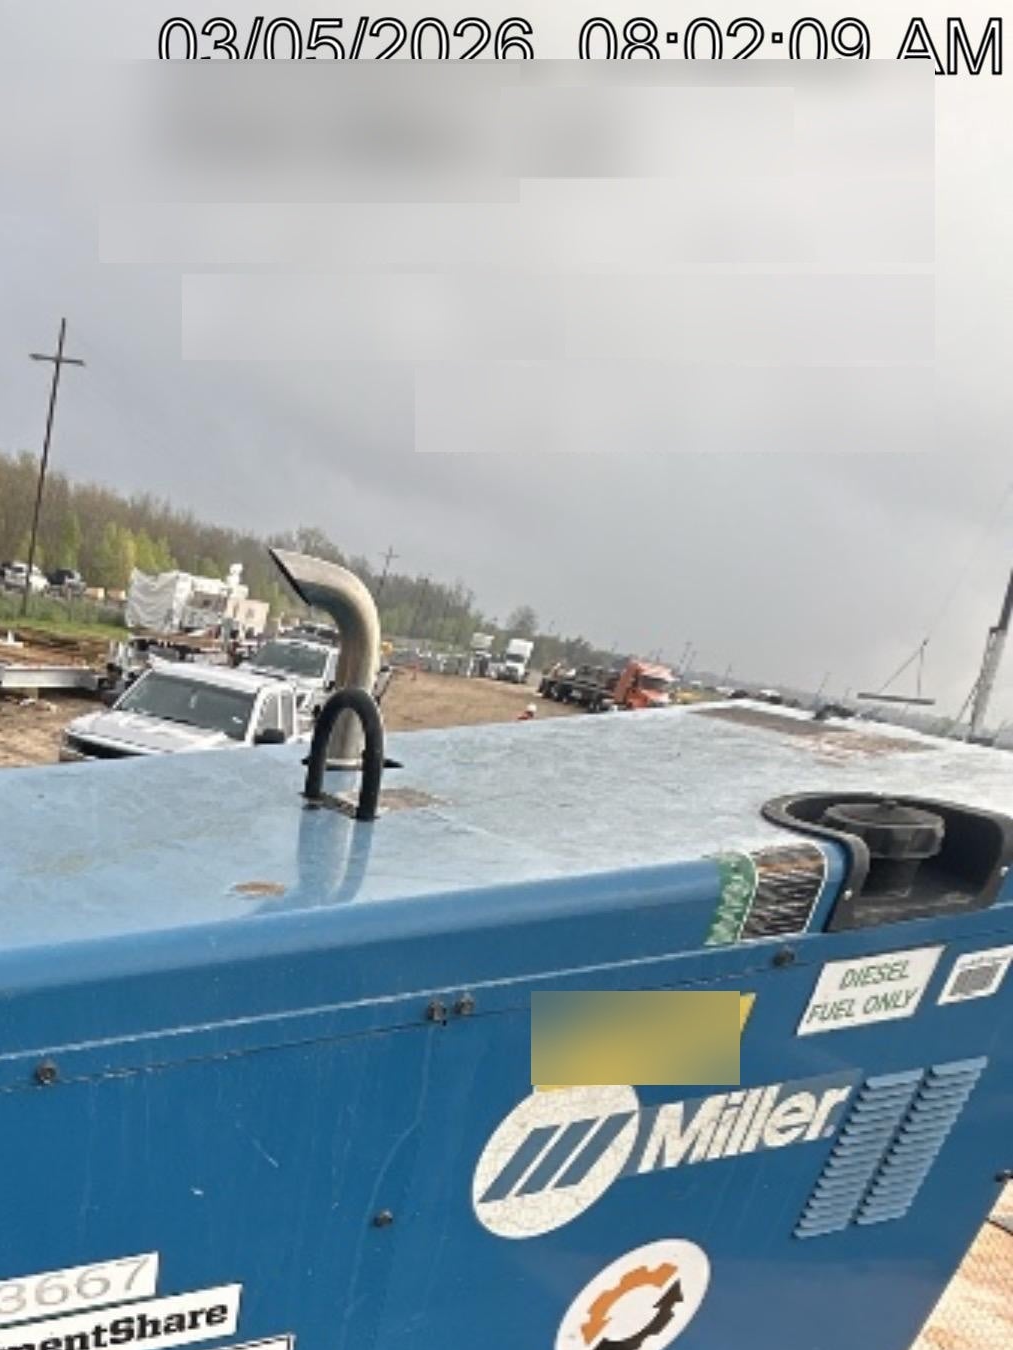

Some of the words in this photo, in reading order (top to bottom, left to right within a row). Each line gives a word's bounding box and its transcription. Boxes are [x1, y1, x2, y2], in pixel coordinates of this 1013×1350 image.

[838, 959, 910, 991] DIESEL
[806, 999, 856, 1025] FUEL
[862, 987, 918, 1014] ONLY
[637, 1084, 852, 1174] Miller
